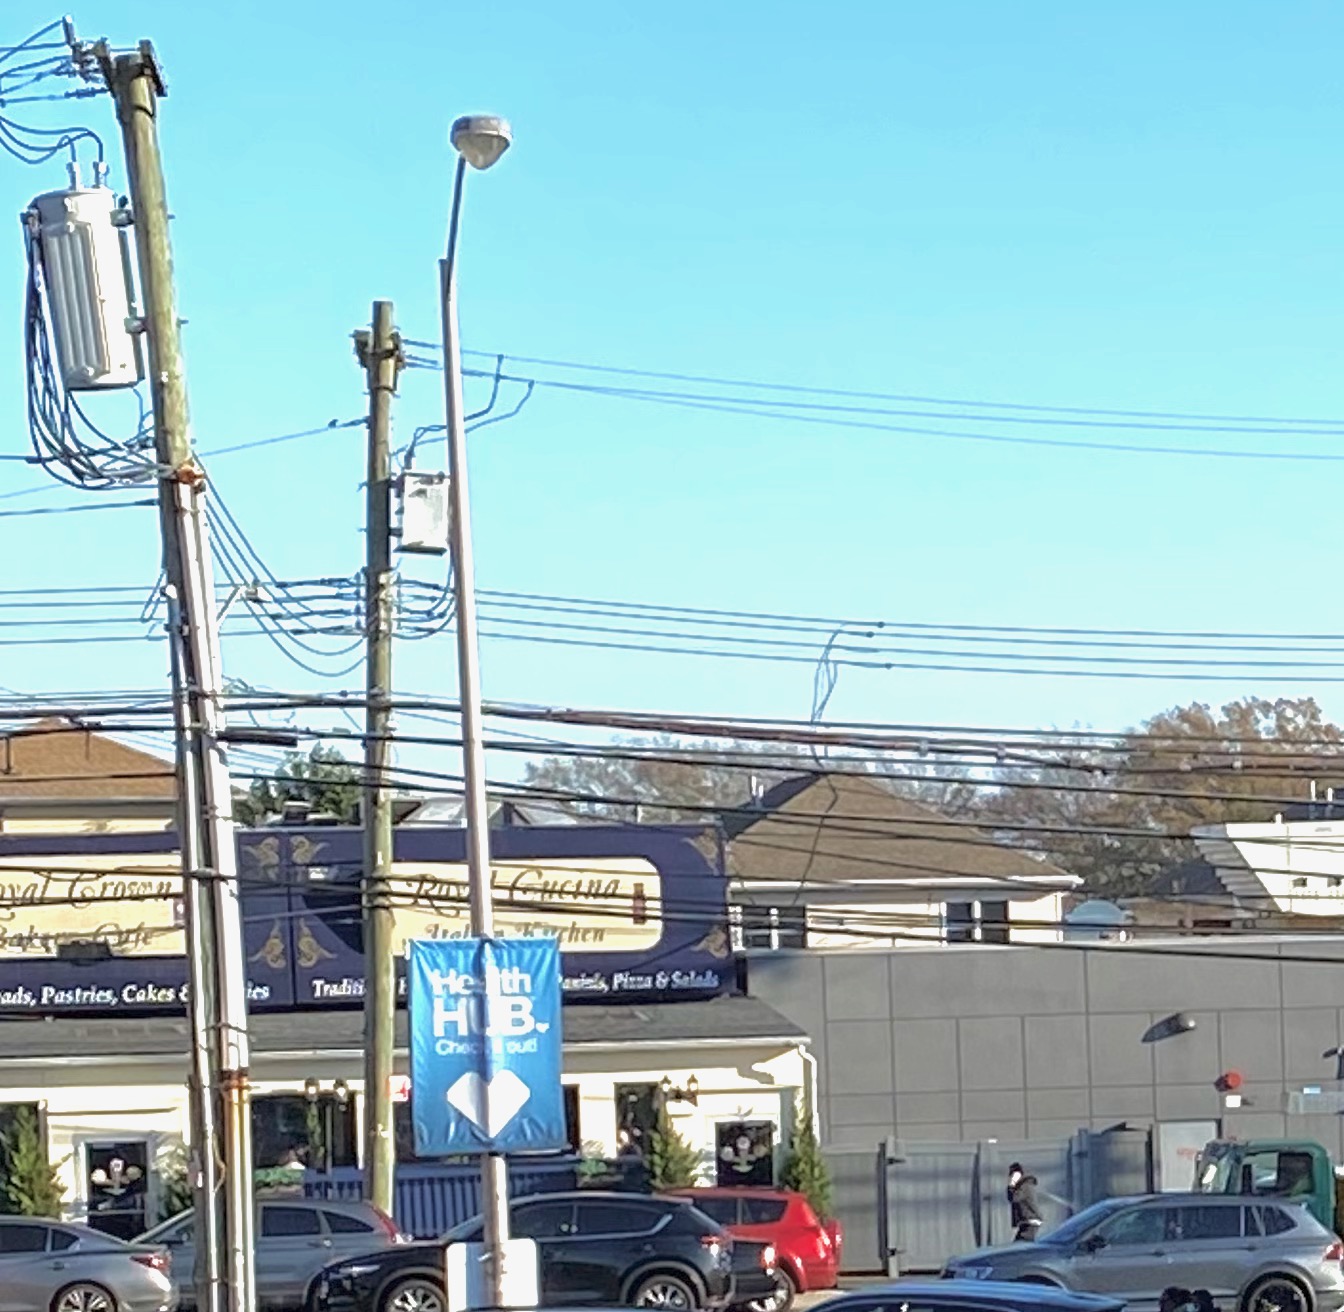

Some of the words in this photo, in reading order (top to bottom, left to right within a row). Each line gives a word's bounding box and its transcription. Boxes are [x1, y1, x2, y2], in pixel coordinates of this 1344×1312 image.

[406, 869, 498, 918] Royl
[432, 966, 532, 995] Helth
[655, 971, 670, 989] &
[671, 970, 720, 989] Salads
[0, 985, 36, 1006] ads,
[41, 984, 118, 1006] Pastries,
[122, 984, 175, 1003] Cakes
[433, 996, 536, 1037] HUB
[436, 1039, 484, 1056] Chec
